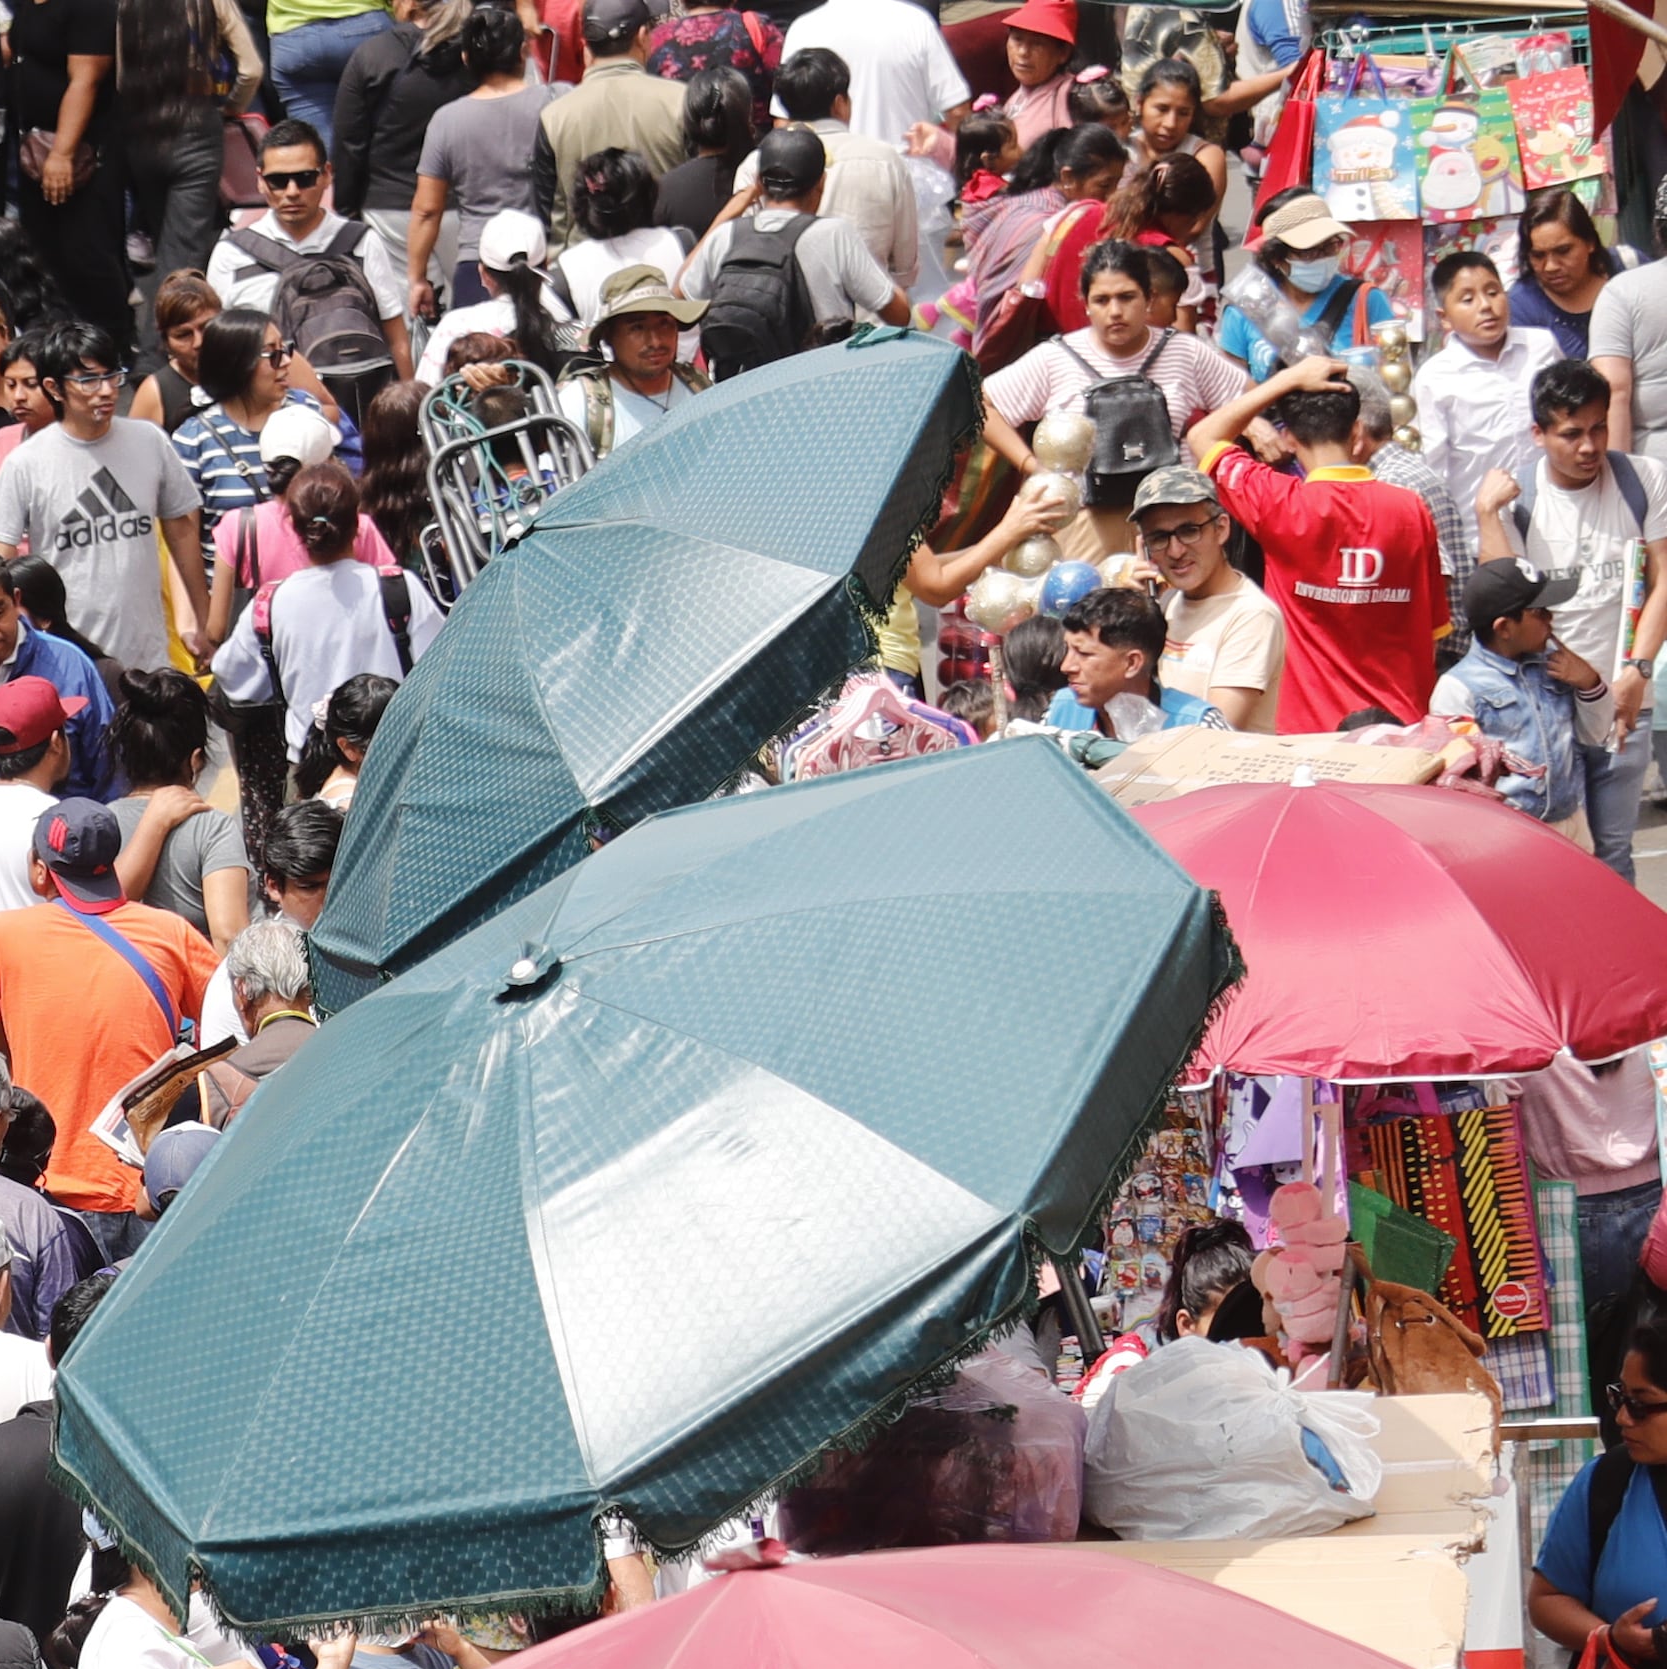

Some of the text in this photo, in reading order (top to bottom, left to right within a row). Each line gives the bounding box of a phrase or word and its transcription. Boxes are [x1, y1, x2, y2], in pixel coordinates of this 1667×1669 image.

[54, 515, 153, 551] adidas
[1337, 547, 1384, 584] ID
[1591, 560, 1625, 580] YOR
